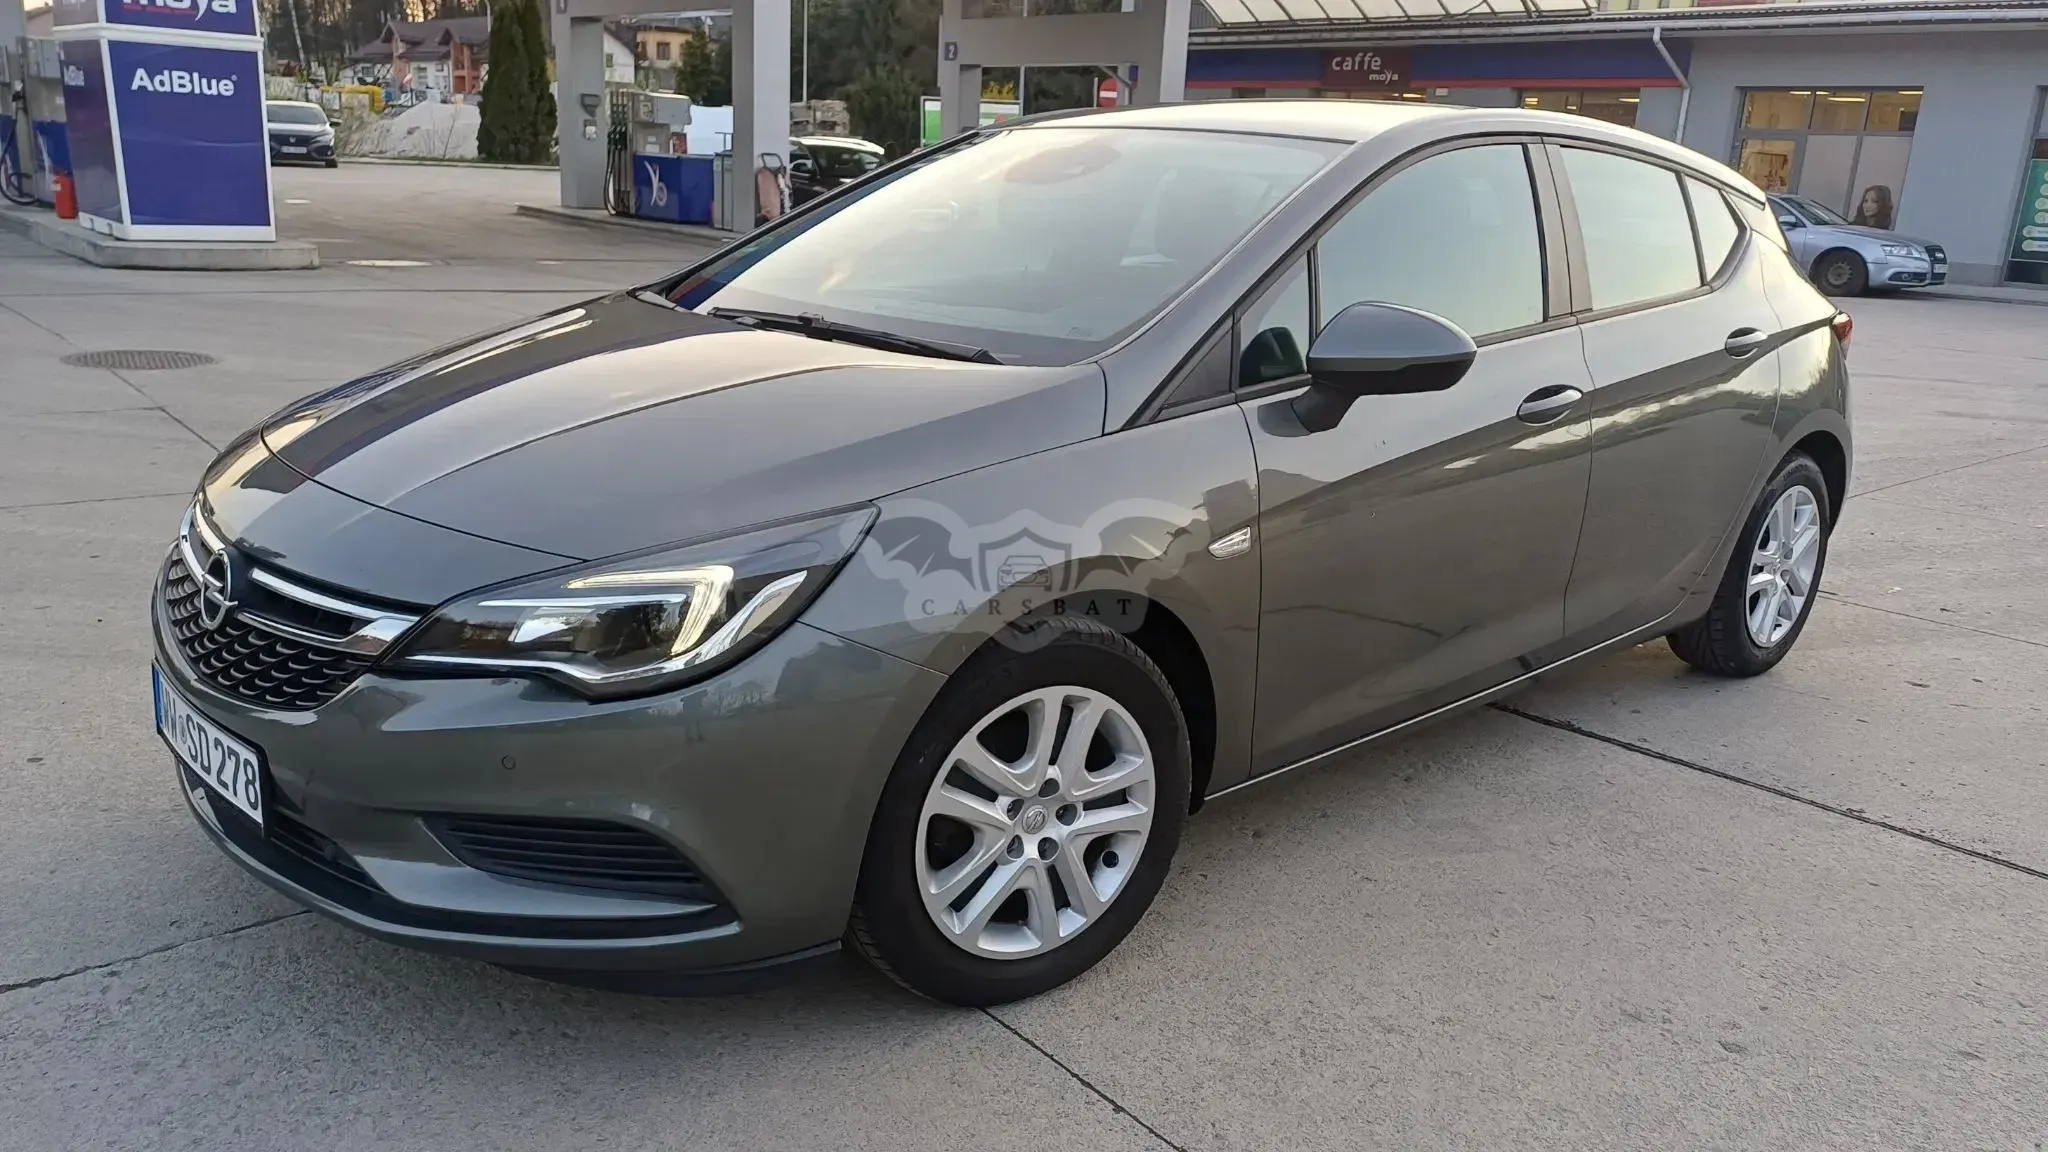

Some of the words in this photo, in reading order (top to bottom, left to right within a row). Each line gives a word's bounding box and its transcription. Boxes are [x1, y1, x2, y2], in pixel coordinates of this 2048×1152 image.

[122, 0, 237, 21] ya
[1332, 52, 1382, 71] caffe
[1369, 69, 1399, 85] moya
[185, 713, 212, 776] SD
[213, 736, 259, 811] 278
